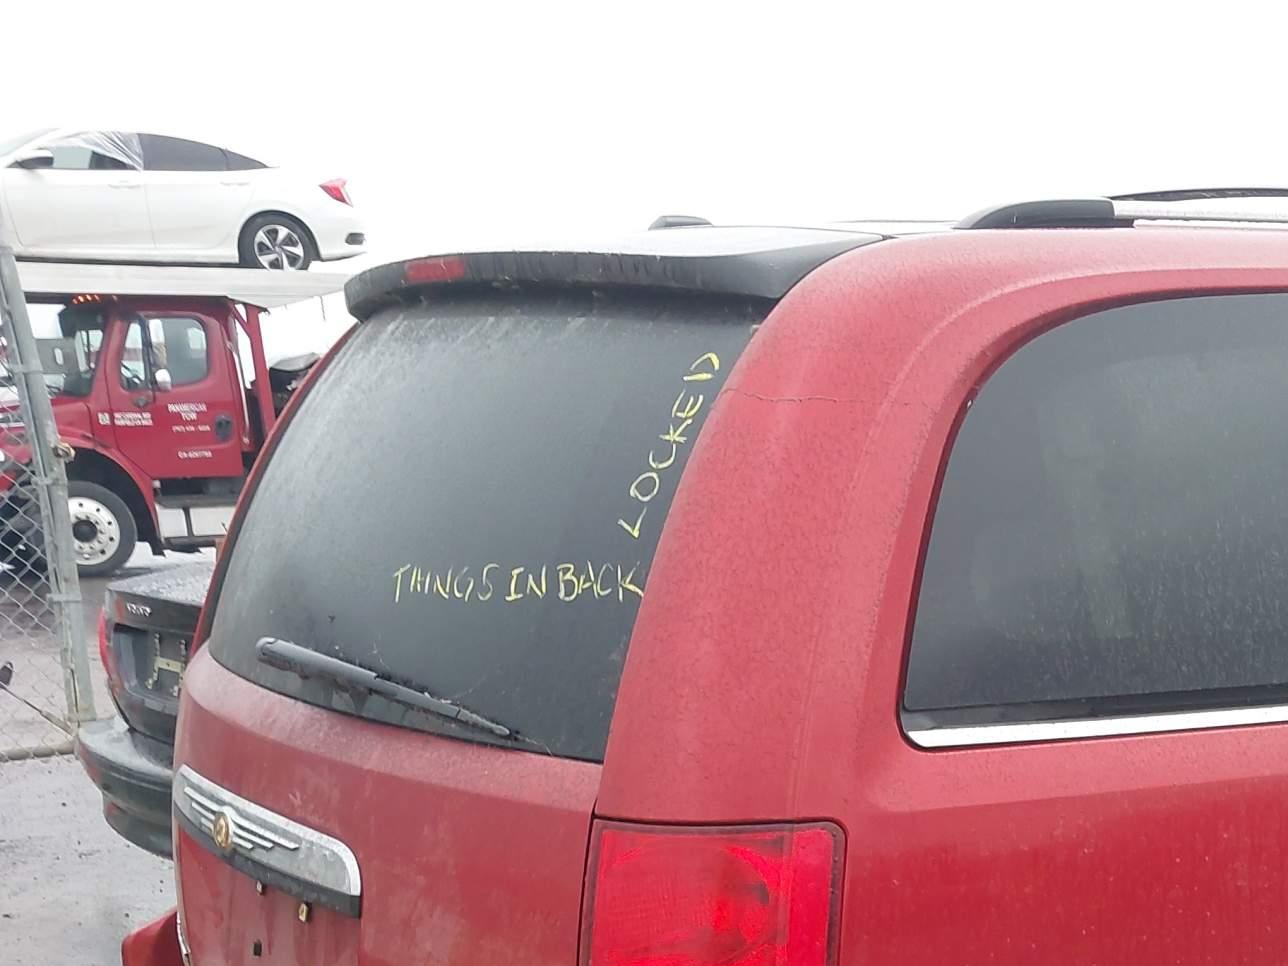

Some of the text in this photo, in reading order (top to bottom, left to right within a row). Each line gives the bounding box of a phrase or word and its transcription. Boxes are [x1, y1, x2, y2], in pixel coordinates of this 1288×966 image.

[617, 352, 720, 539] LOCKED
[393, 560, 645, 603] THINGS IN BACK
